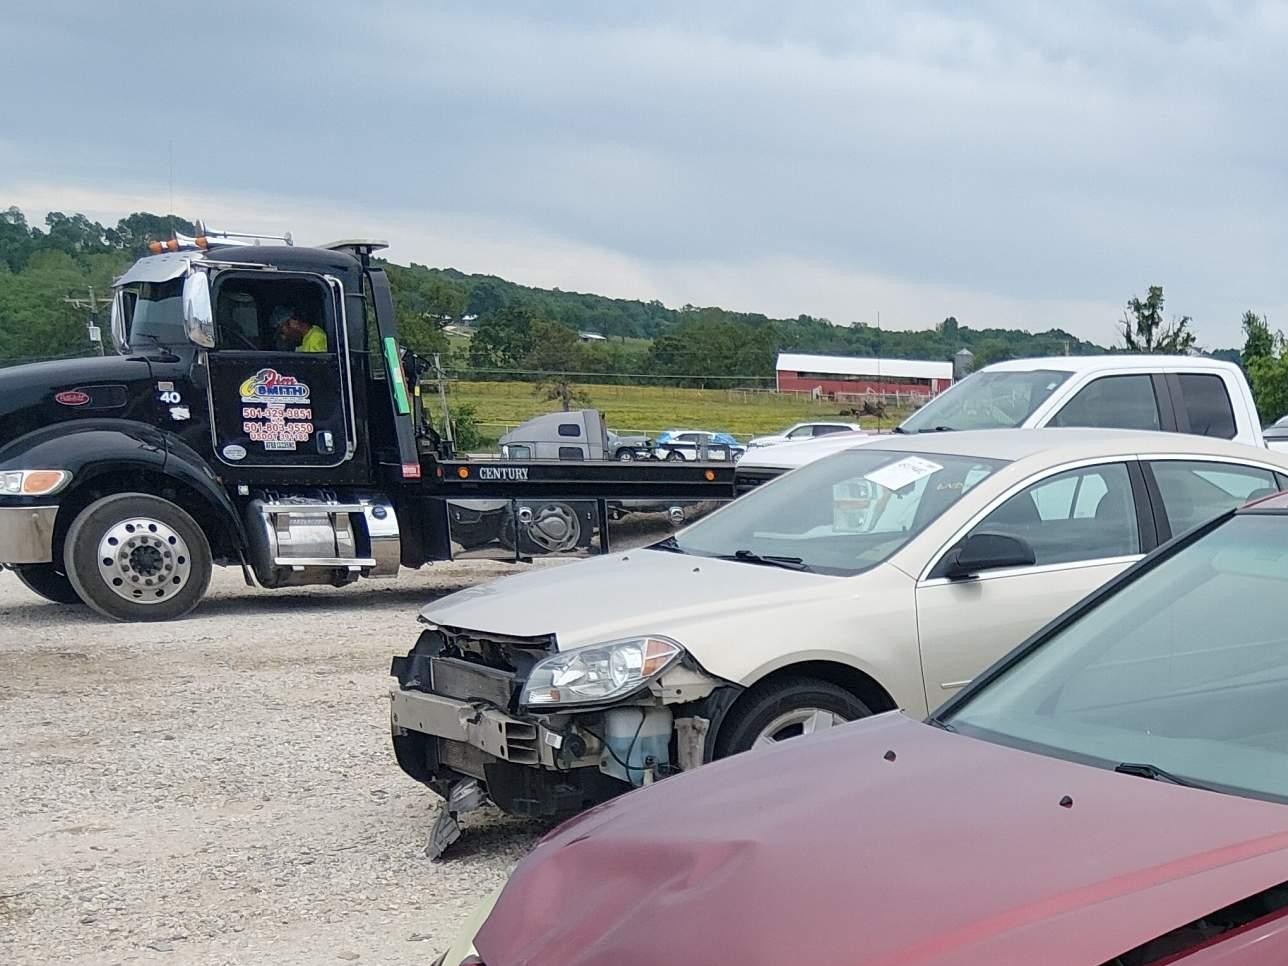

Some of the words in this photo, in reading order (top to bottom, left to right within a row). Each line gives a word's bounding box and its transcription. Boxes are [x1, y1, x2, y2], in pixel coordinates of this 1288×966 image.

[258, 385, 304, 396] SMITH
[159, 392, 181, 404] 40
[479, 467, 529, 480] CENTURY
